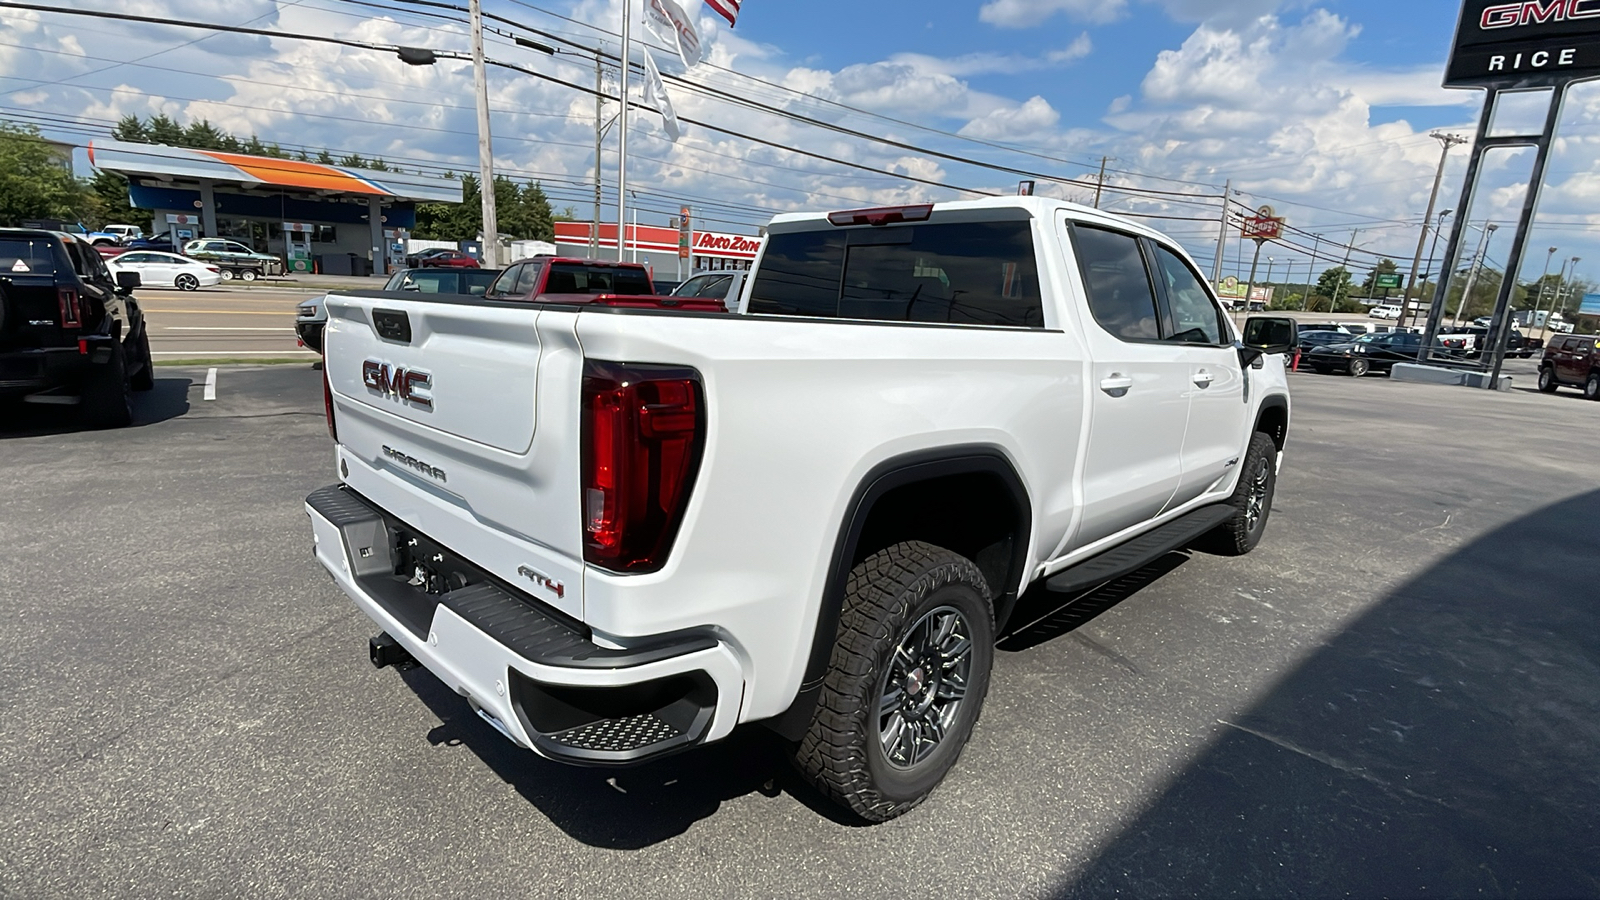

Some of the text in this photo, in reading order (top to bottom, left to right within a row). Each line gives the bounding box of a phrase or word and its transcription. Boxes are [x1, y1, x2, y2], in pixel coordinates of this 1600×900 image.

[1480, 0, 1600, 30] GMC
[1488, 48, 1577, 71] RICE
[362, 357, 436, 414] GMC
[382, 444, 448, 484] SIERRA
